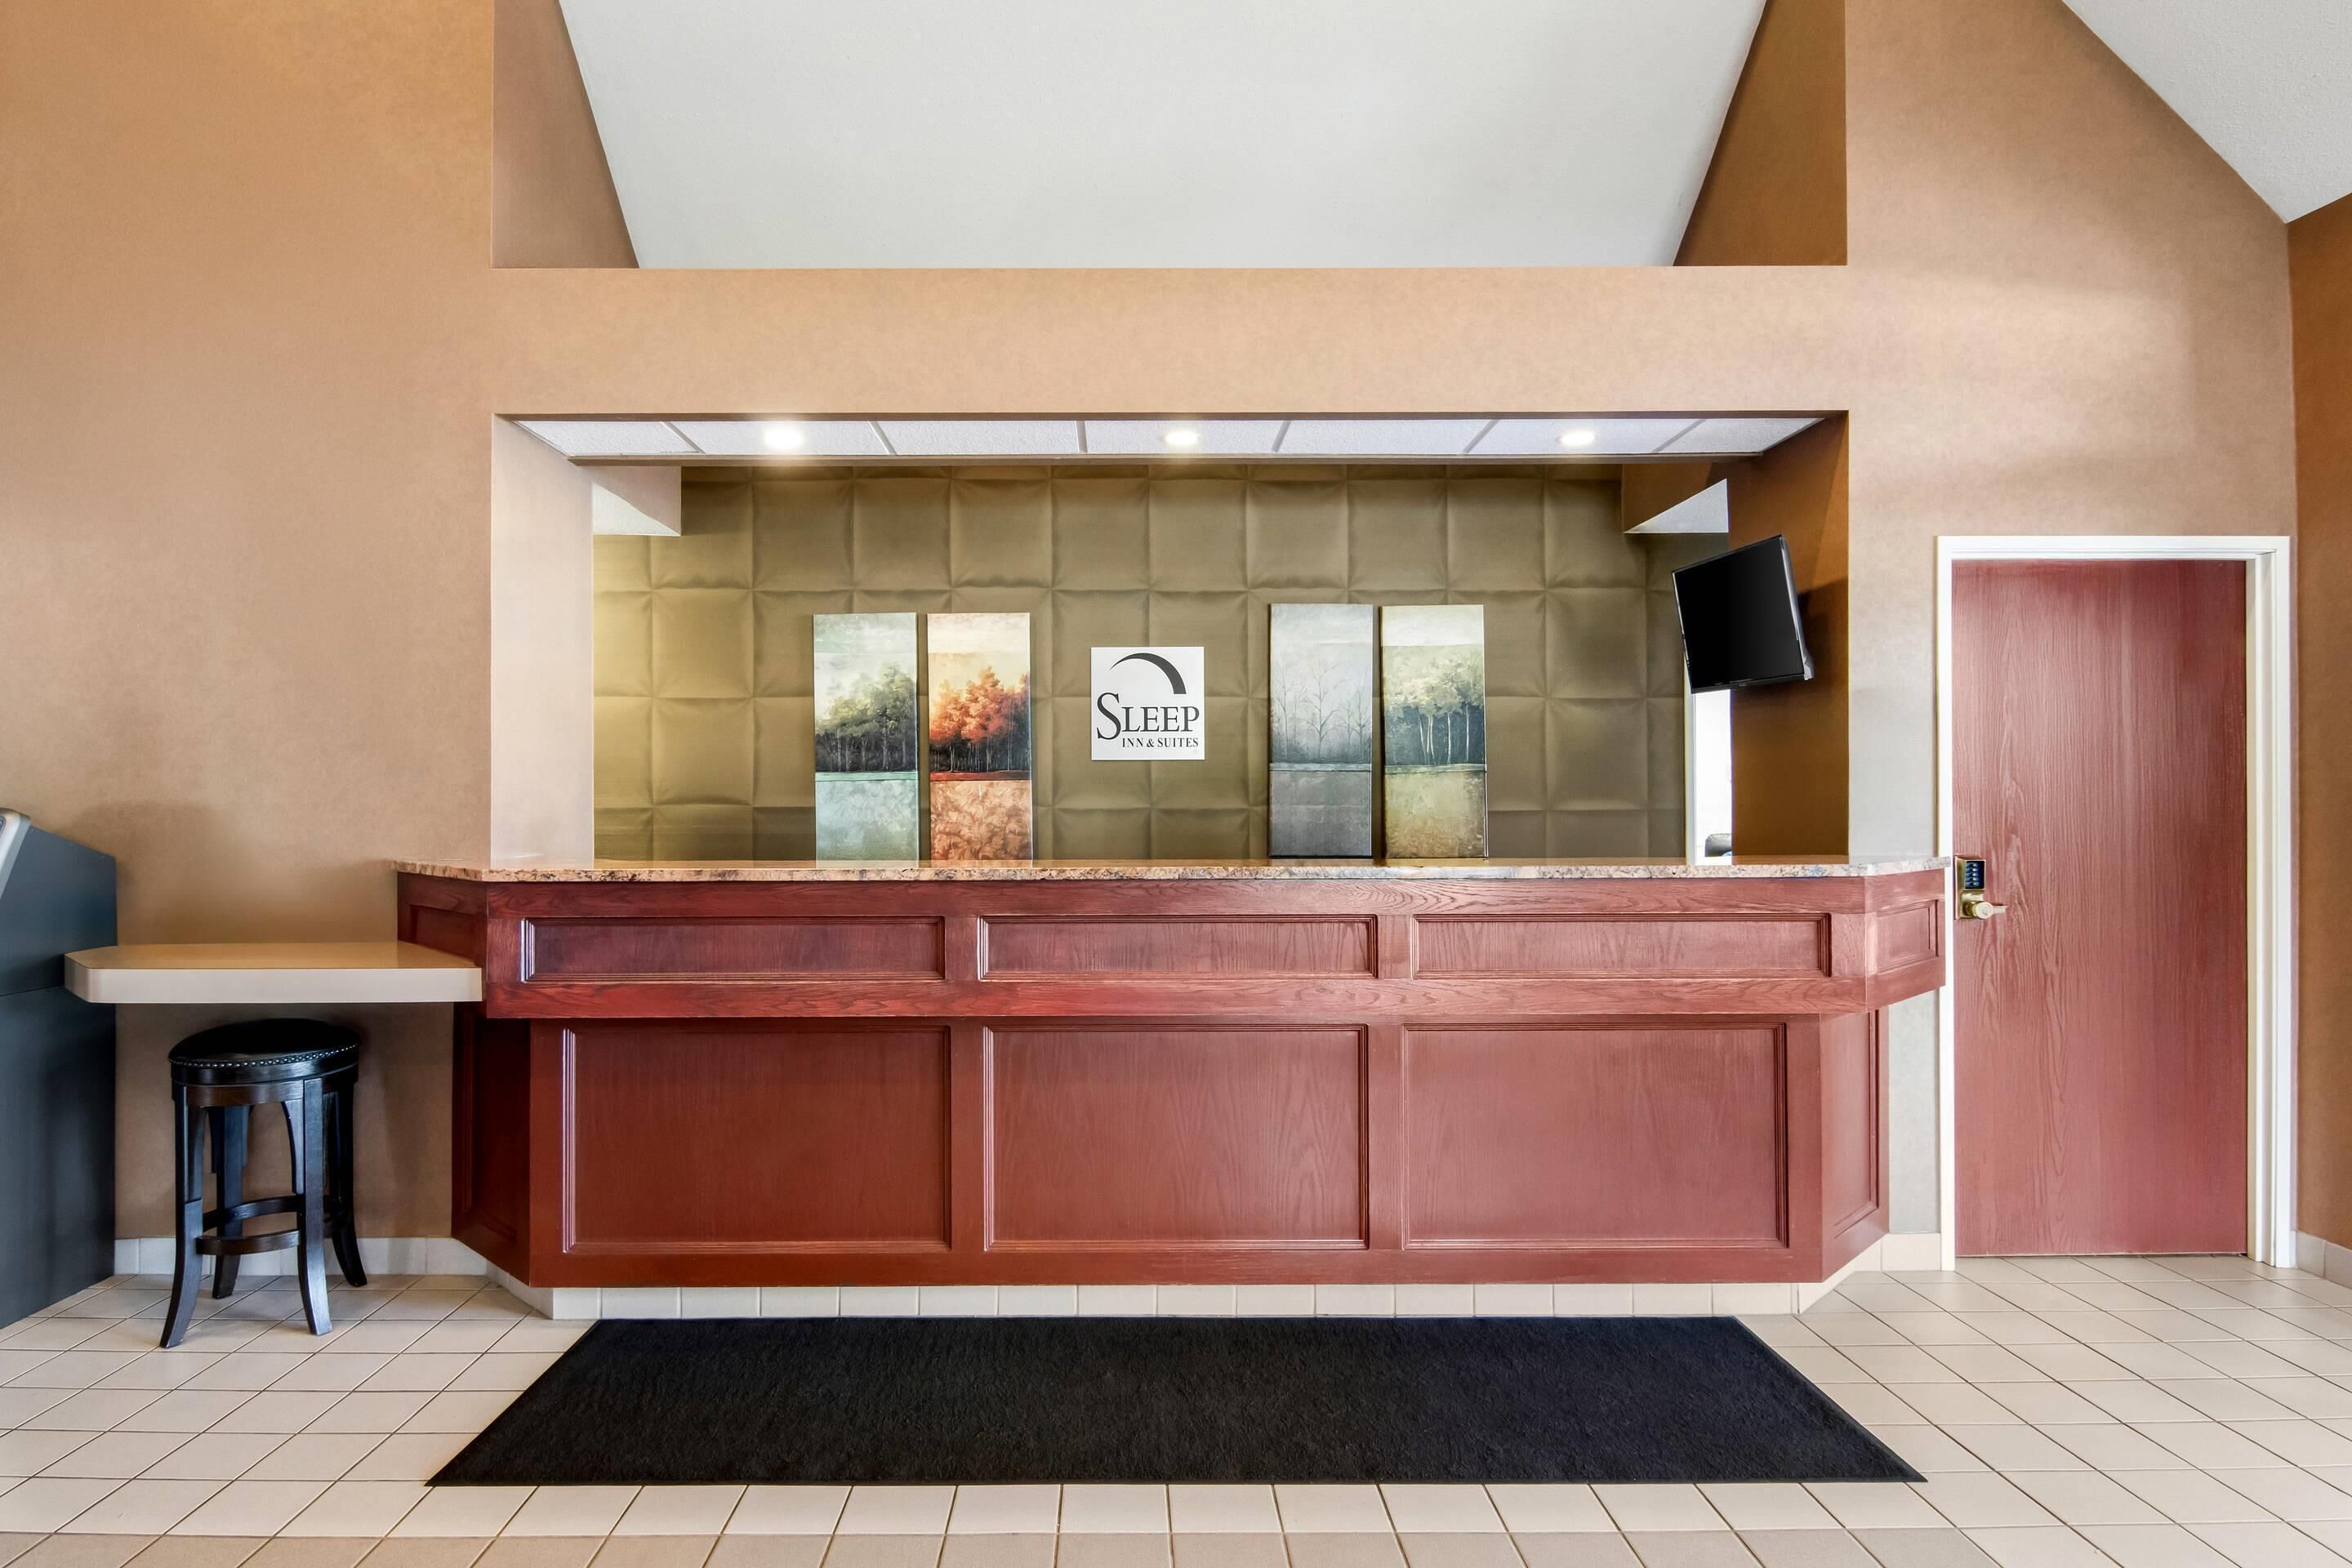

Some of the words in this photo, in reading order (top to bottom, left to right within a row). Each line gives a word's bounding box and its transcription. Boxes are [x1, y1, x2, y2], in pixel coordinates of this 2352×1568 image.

[1097, 693, 1200, 740] SLEEP
[1122, 738, 1143, 747] INN
[1147, 738, 1154, 747] &
[1157, 738, 1198, 747] SUITES
